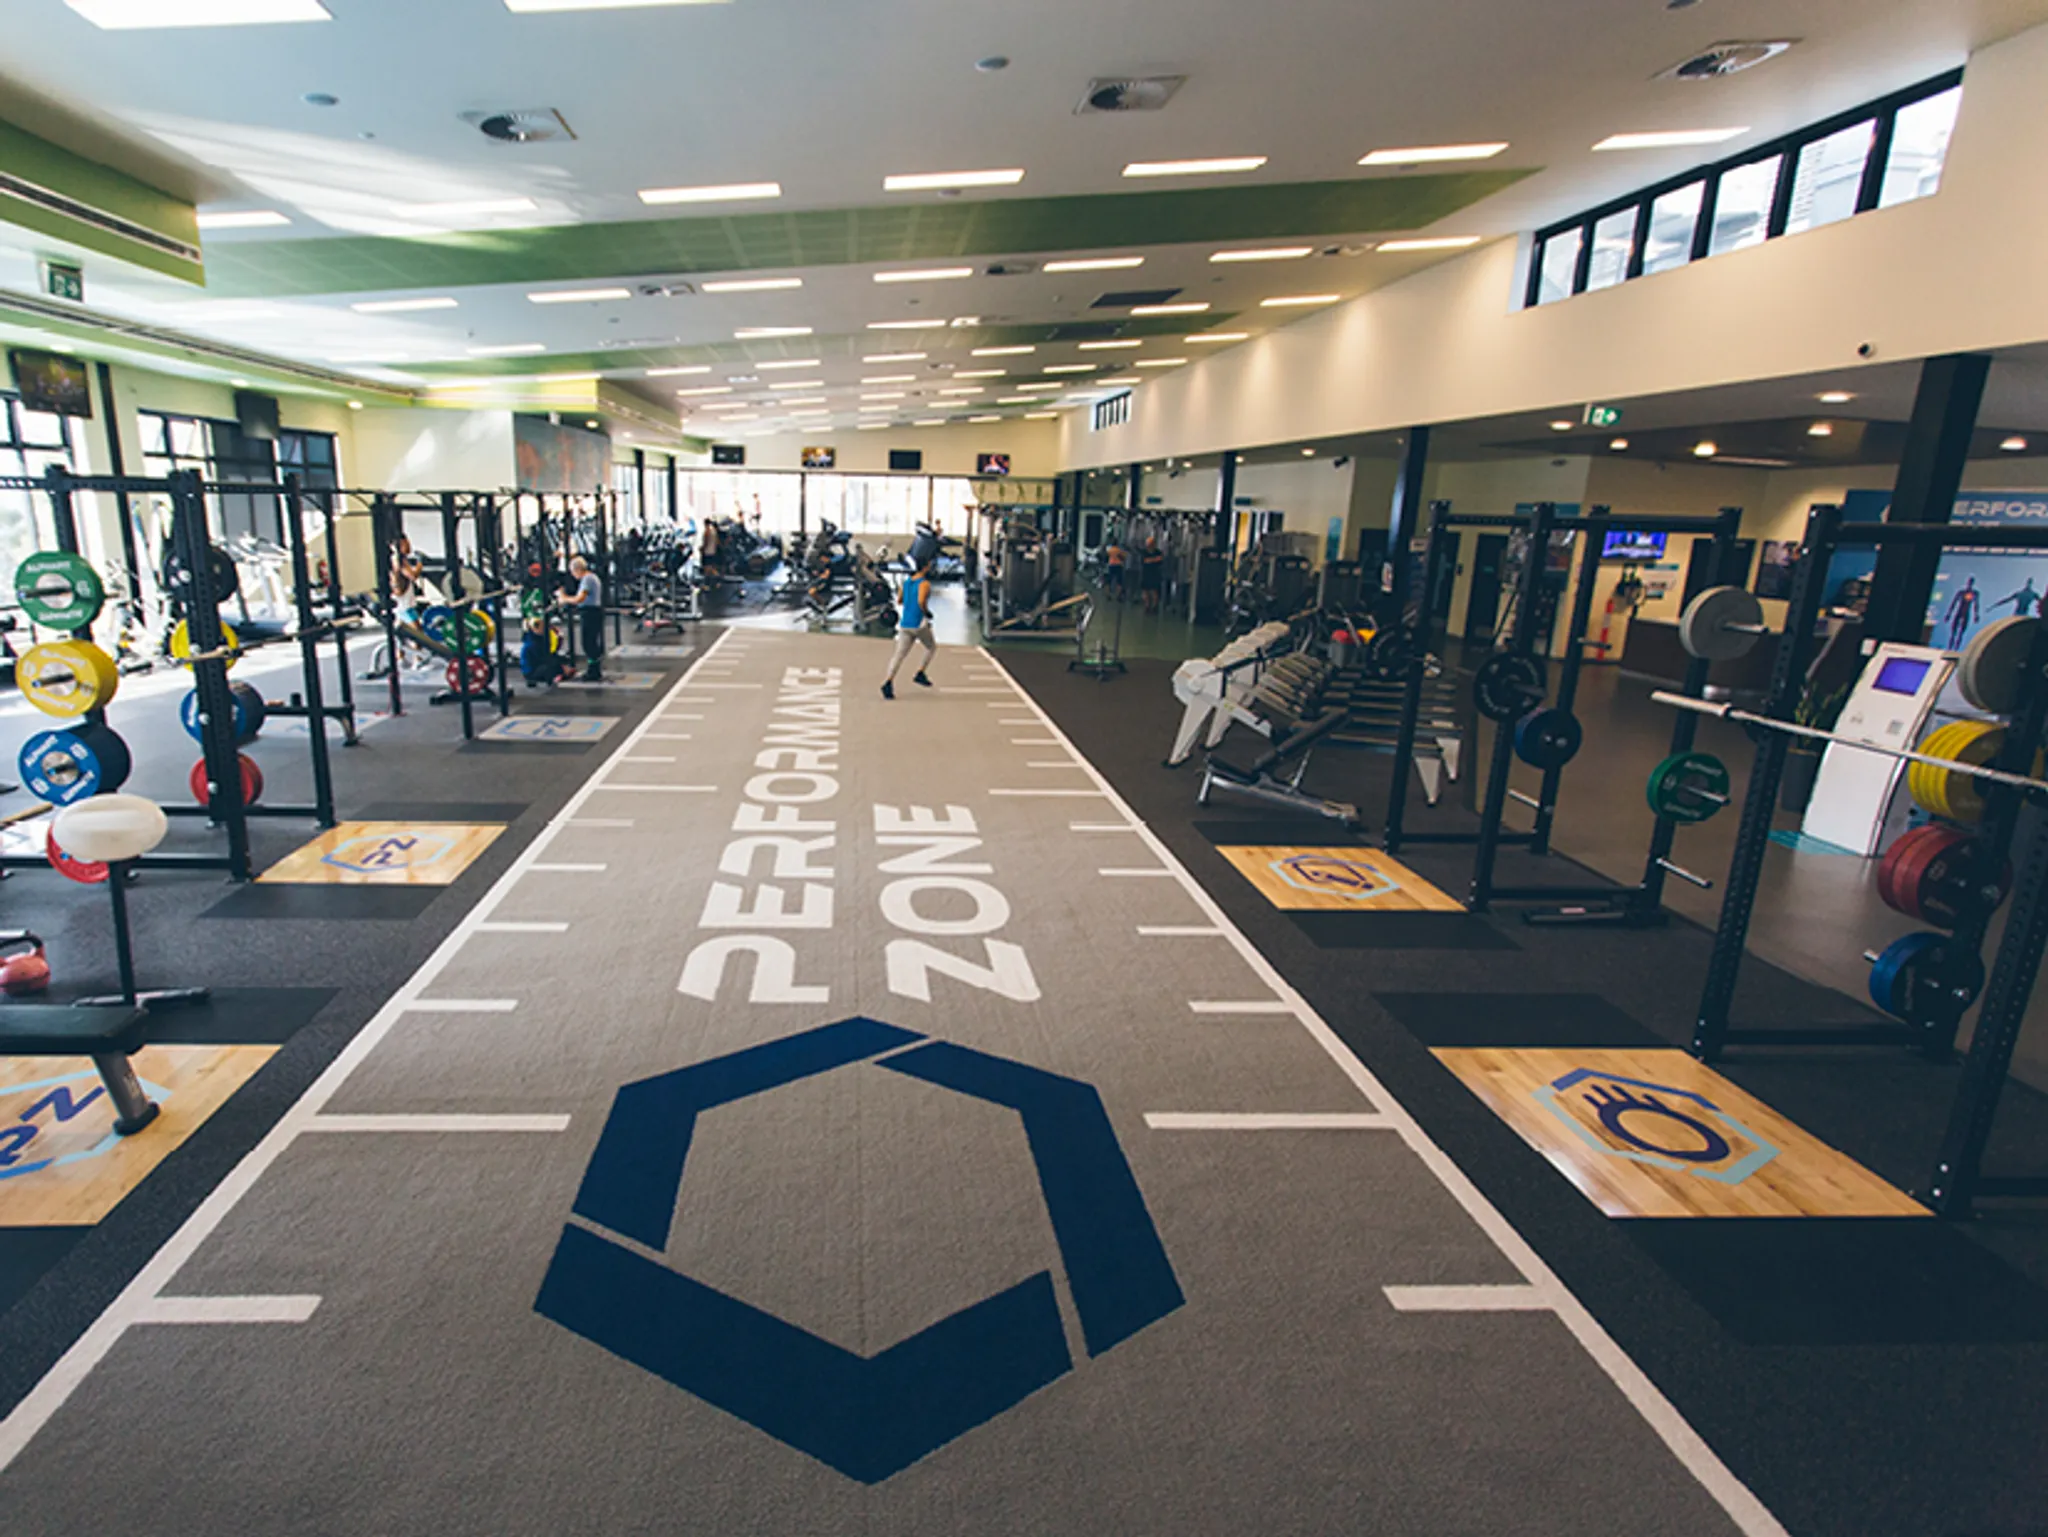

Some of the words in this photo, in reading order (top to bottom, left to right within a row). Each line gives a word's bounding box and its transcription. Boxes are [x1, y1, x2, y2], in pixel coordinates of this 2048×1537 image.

[1952, 499, 2048, 519] ERFOR
[676, 665, 843, 1003] PERFORMANCE
[872, 802, 1042, 1003] ZONE
